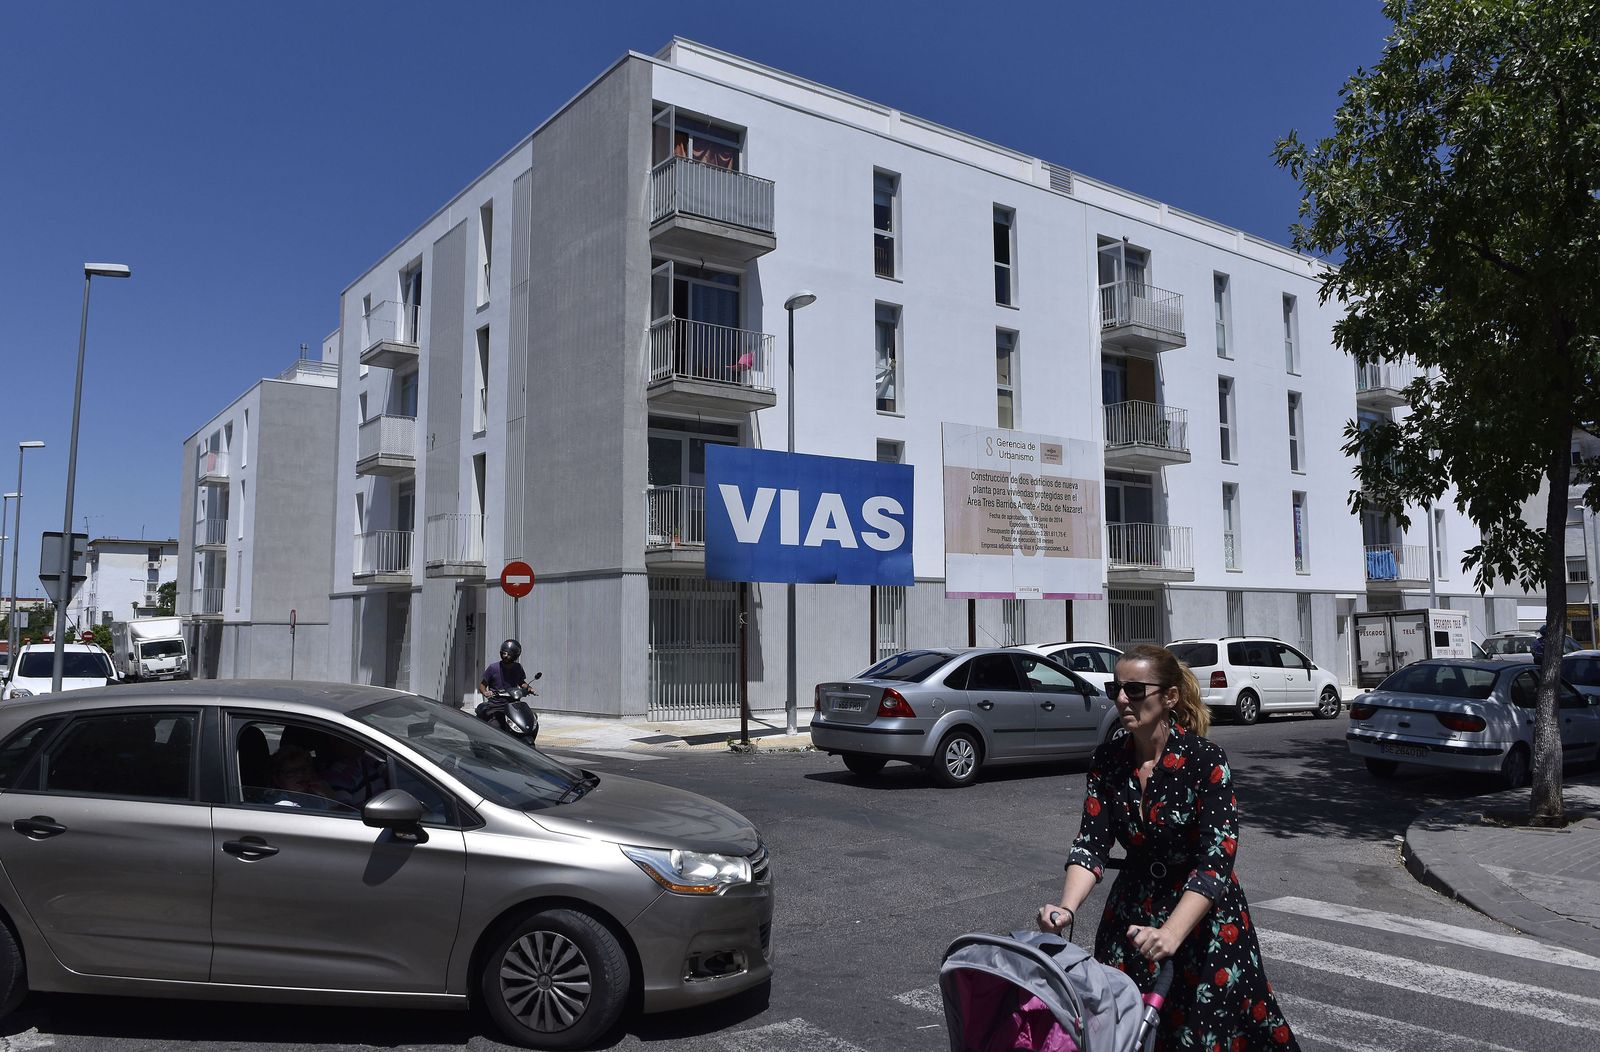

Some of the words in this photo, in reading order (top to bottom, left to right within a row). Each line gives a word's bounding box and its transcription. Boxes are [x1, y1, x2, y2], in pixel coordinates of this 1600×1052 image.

[996, 438, 1026, 450] Gerencia
[1028, 442, 1036, 450] de
[998, 450, 1034, 462] Urbanismo
[970, 471, 1010, 483] Construcción
[1010, 476, 1018, 484] de
[1018, 476, 1030, 485] dos
[1030, 478, 1054, 488] edificios
[1054, 480, 1062, 488] de
[1062, 482, 1078, 490] nueva
[972, 485, 992, 495] planta
[992, 488, 1006, 496] para
[1007, 488, 1034, 498] viviendas
[1035, 491, 1064, 502] protegidas
[1072, 494, 1078, 502] el
[968, 494, 981, 506] Área
[982, 497, 995, 507] Tres
[996, 498, 1017, 509] Barrios
[1018, 502, 1036, 510] Amate
[1040, 502, 1054, 512] Bda.
[1054, 504, 1062, 512] de
[1062, 505, 1083, 514] Nazaret
[718, 483, 906, 552] VIAS
[981, 542, 998, 550] Empresa
